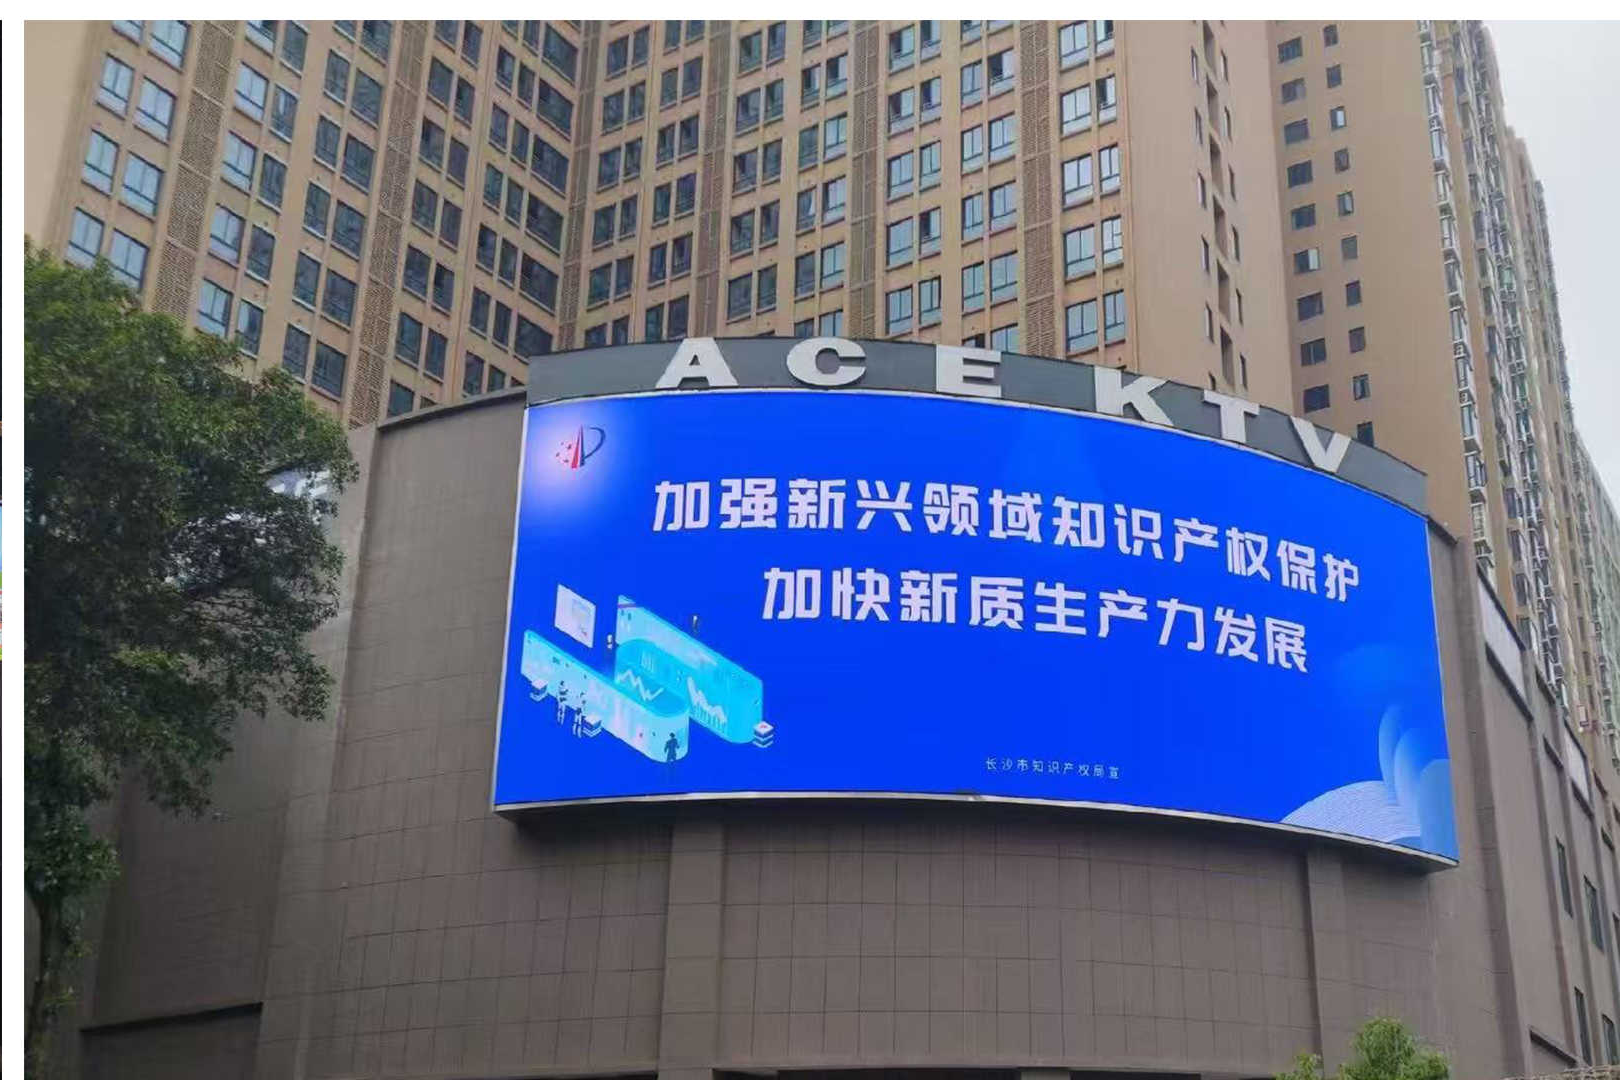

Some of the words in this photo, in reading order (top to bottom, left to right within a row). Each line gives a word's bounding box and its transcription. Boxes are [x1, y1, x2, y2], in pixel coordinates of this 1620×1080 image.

[655, 336, 1003, 398] ACE
[1092, 366, 1354, 473] KTV
[651, 478, 1361, 604] 加强新兴领域知识产权保护
[762, 566, 1309, 674] 加快新质生产力发展
[984, 756, 1121, 781] 长沙市知识产权局宣
